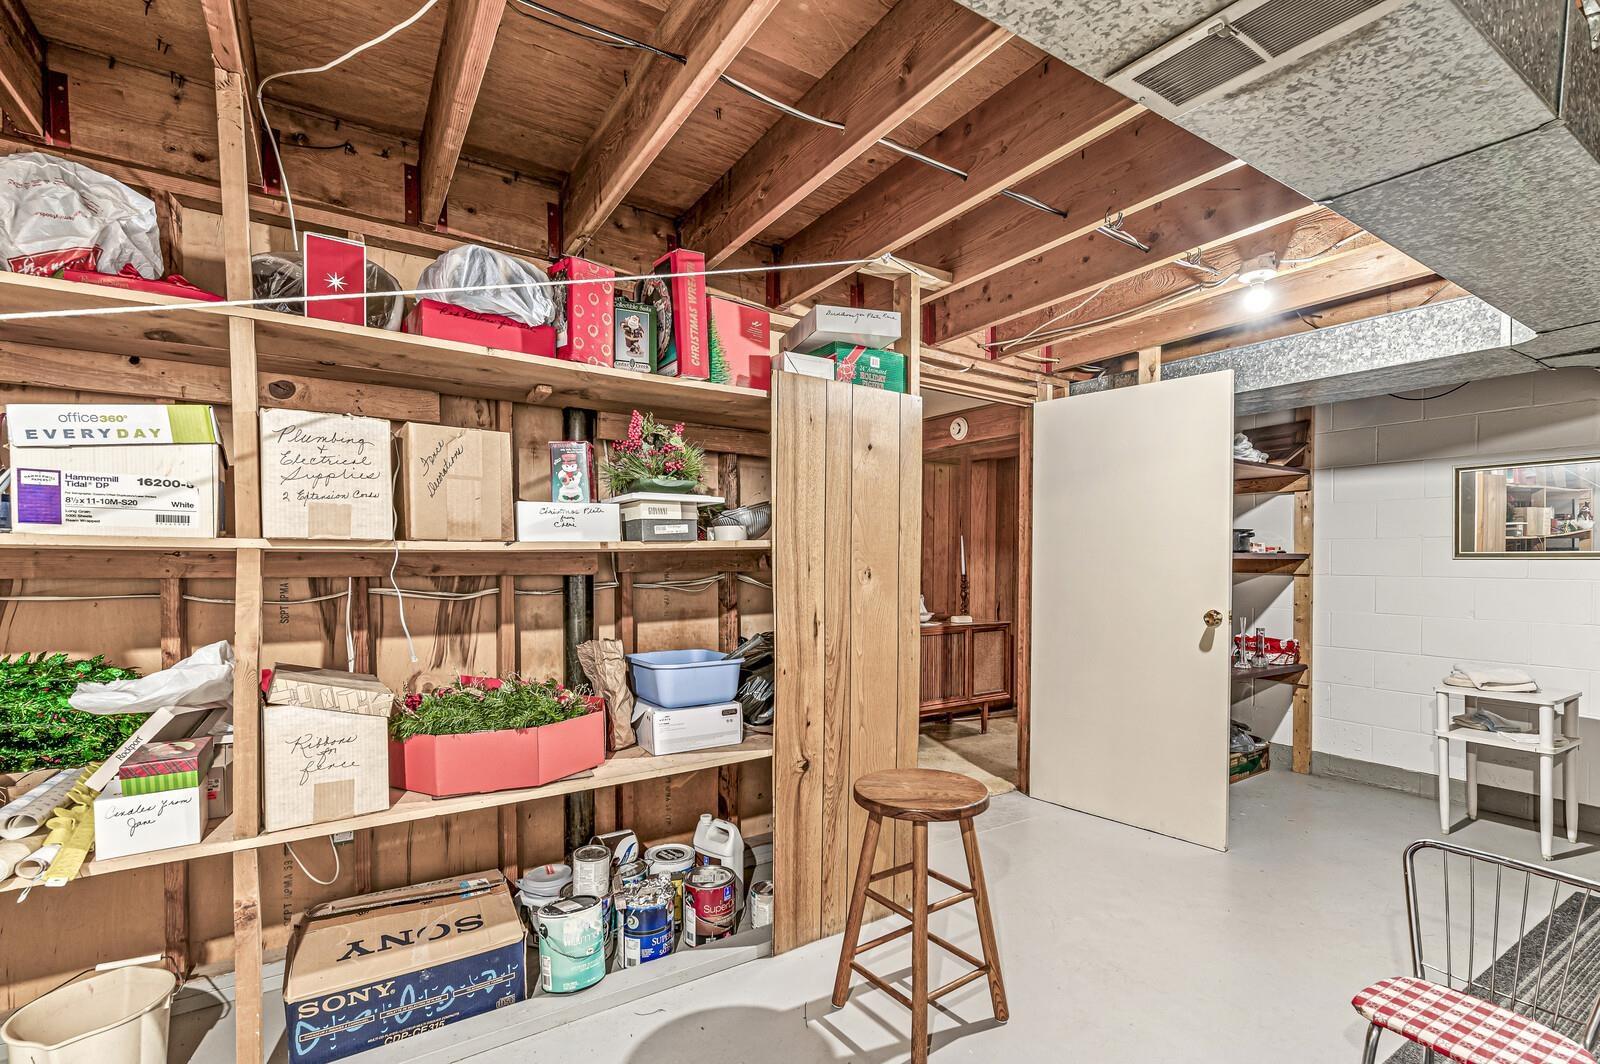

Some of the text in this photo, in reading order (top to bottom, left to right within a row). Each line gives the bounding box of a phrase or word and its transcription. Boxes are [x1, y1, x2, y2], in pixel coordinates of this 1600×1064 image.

[689, 306, 700, 367] CHRISTMAS
[25, 428, 160, 440] EVERYDAY
[272, 425, 375, 455] Plumbing
[280, 450, 372, 466] Electrical
[65, 473, 119, 483] Hammermill
[95, 481, 109, 489] DP
[280, 466, 380, 489] Supplies
[171, 501, 195, 509] White
[282, 491, 290, 502] 2
[115, 734, 144, 763] Rockport
[285, 733, 358, 759] Ribbons
[126, 818, 156, 838] Jane
[298, 980, 396, 1020] SONY
